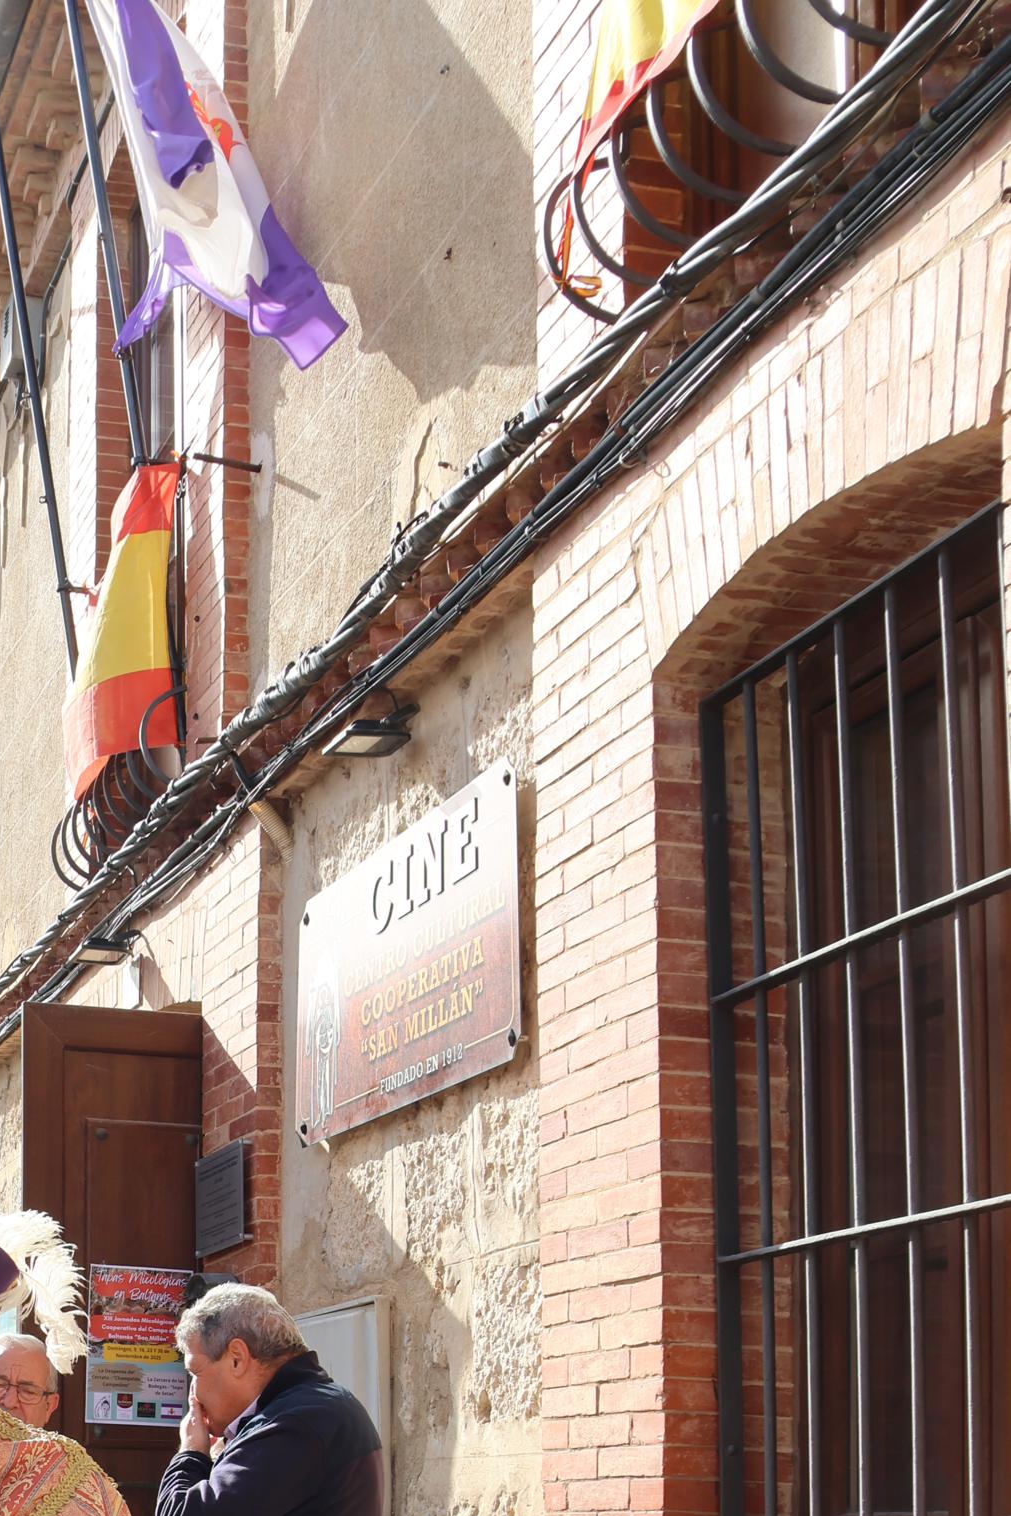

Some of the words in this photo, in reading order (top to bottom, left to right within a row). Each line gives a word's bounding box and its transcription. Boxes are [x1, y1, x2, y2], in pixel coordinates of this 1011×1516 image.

[365, 796, 479, 935] CINE
[344, 940, 408, 998] CENTRO
[412, 884, 507, 959] CULTURAL
[361, 935, 485, 1027] COOPERATIVA
[380, 1062, 424, 1096] FUNDADO
[426, 1053, 440, 1075] EN
[442, 1043, 464, 1069] 1912
[96, 1269, 125, 1285] Tapas
[128, 1271, 188, 1289] Micológicas
[113, 1290, 126, 1299] en
[101, 1323, 137, 1332] Cooperativa
